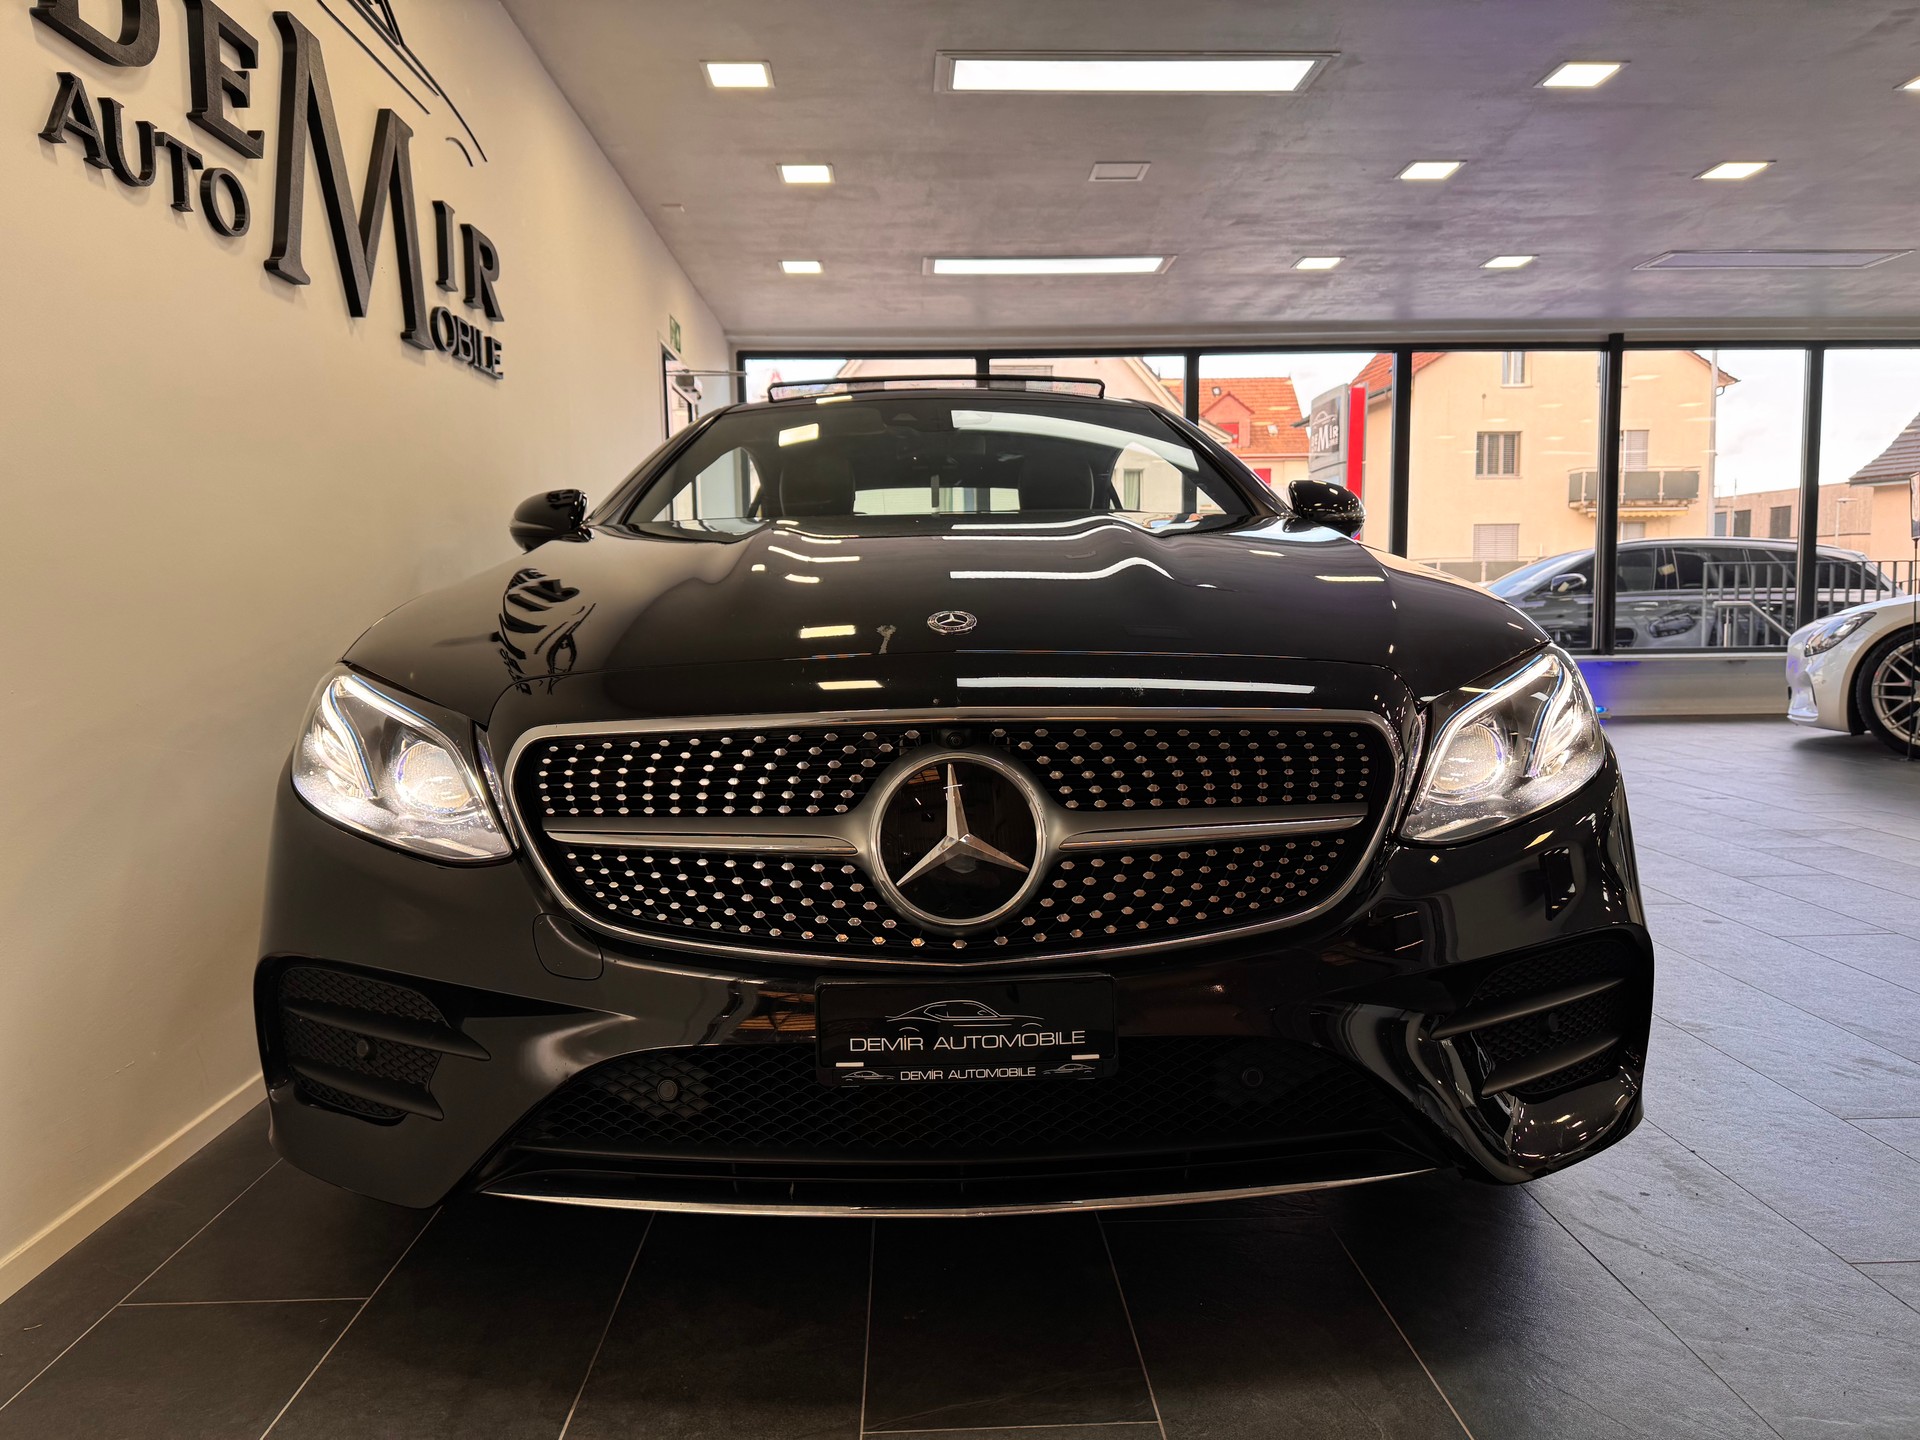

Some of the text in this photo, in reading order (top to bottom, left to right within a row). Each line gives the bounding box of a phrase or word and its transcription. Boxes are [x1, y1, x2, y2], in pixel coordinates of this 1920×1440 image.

[38, 71, 251, 238] AUTO
[933, 1030, 1086, 1051] AUTOMOBILE
[948, 1066, 1036, 1080] AUTOMOBILE
